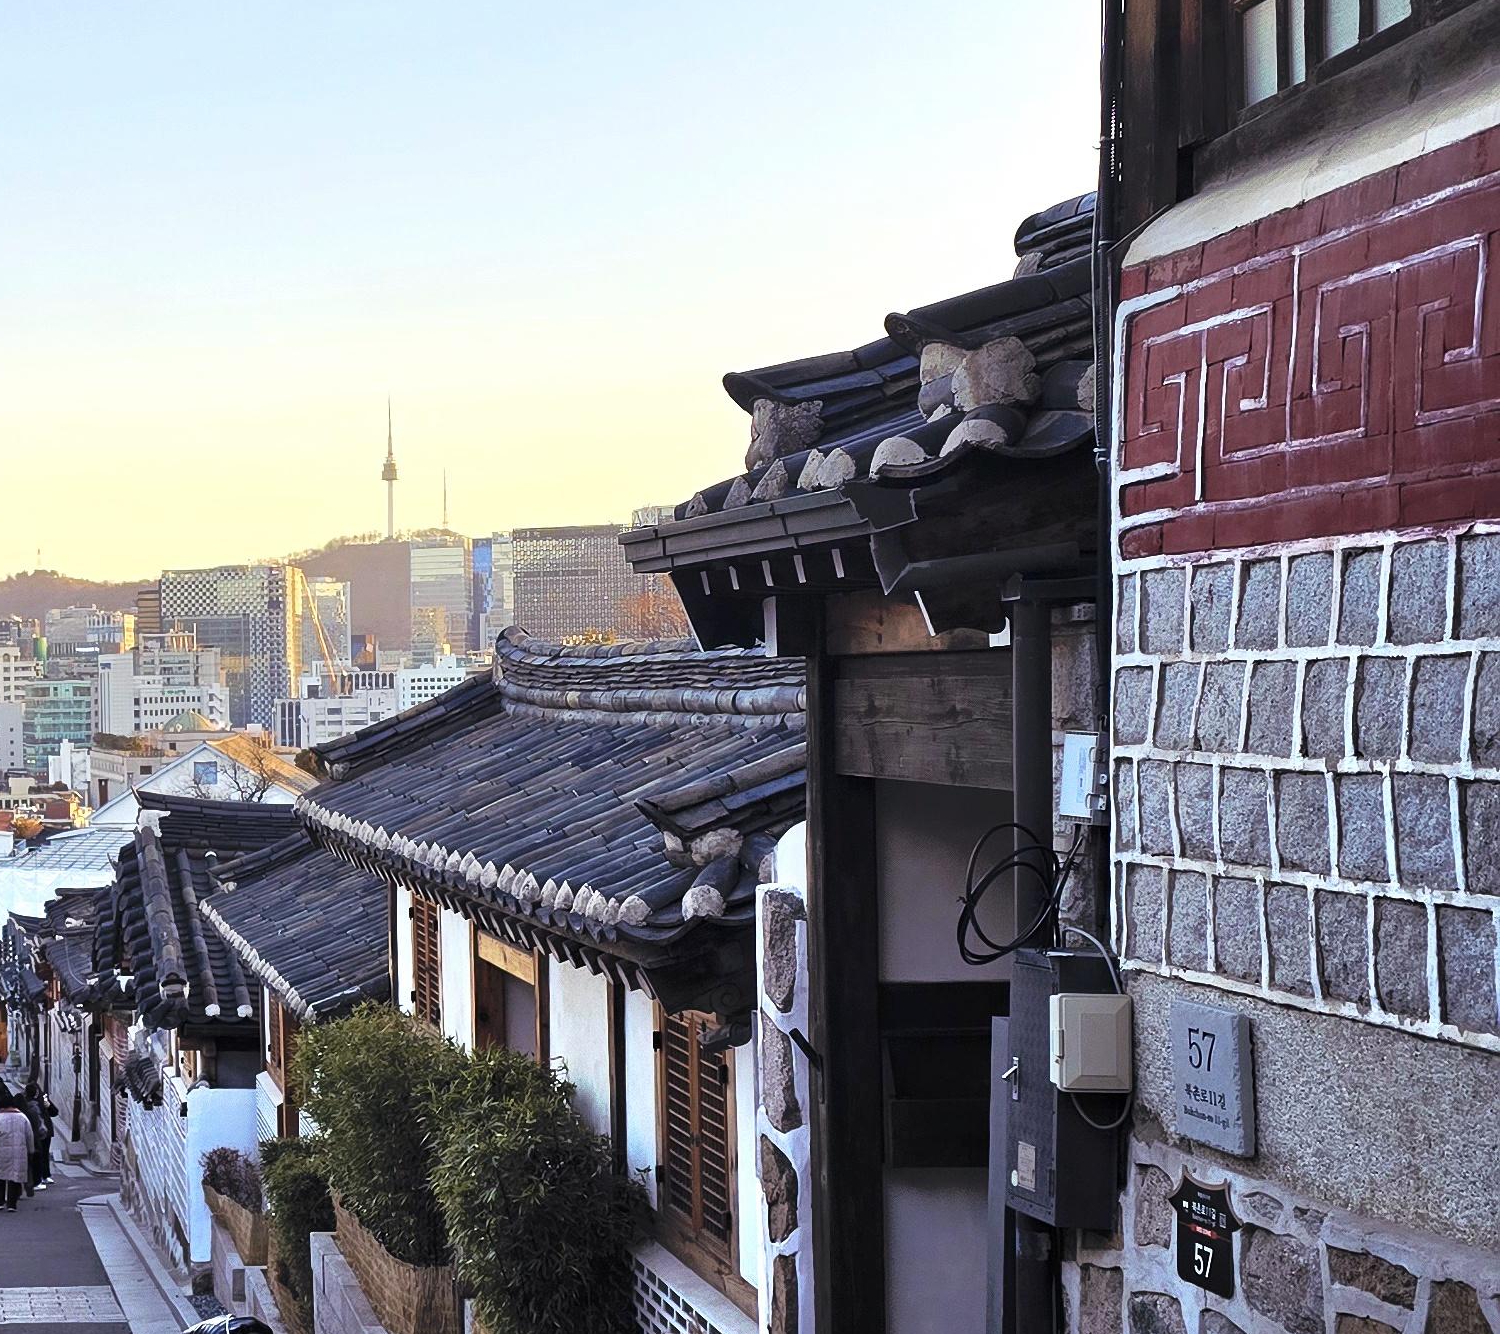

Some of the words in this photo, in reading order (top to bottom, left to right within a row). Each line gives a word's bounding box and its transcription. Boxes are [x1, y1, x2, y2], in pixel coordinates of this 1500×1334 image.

[1188, 1027, 1216, 1072] 57
[1184, 1083, 1227, 1110] 북촌로11길
[1194, 1242, 1214, 1278] 57
